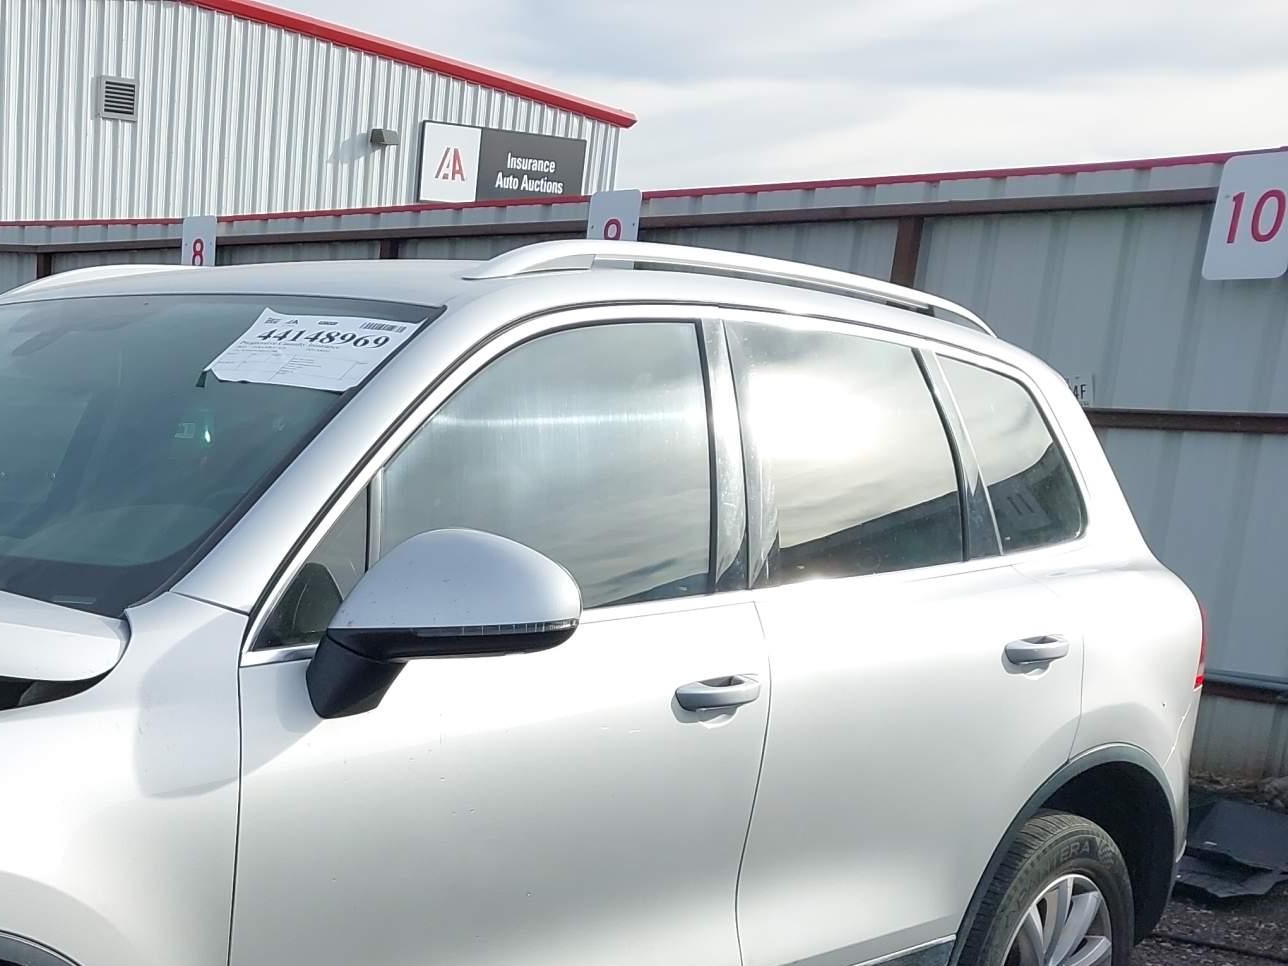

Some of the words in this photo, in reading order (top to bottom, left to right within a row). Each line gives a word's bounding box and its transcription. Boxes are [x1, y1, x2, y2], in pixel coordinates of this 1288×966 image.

[506, 152, 556, 173] Insurance
[495, 171, 519, 190] Auto
[520, 176, 564, 194] Auctions
[1226, 189, 1287, 244] 10
[192, 238, 204, 266] 8
[256, 328, 391, 349] 44148969
